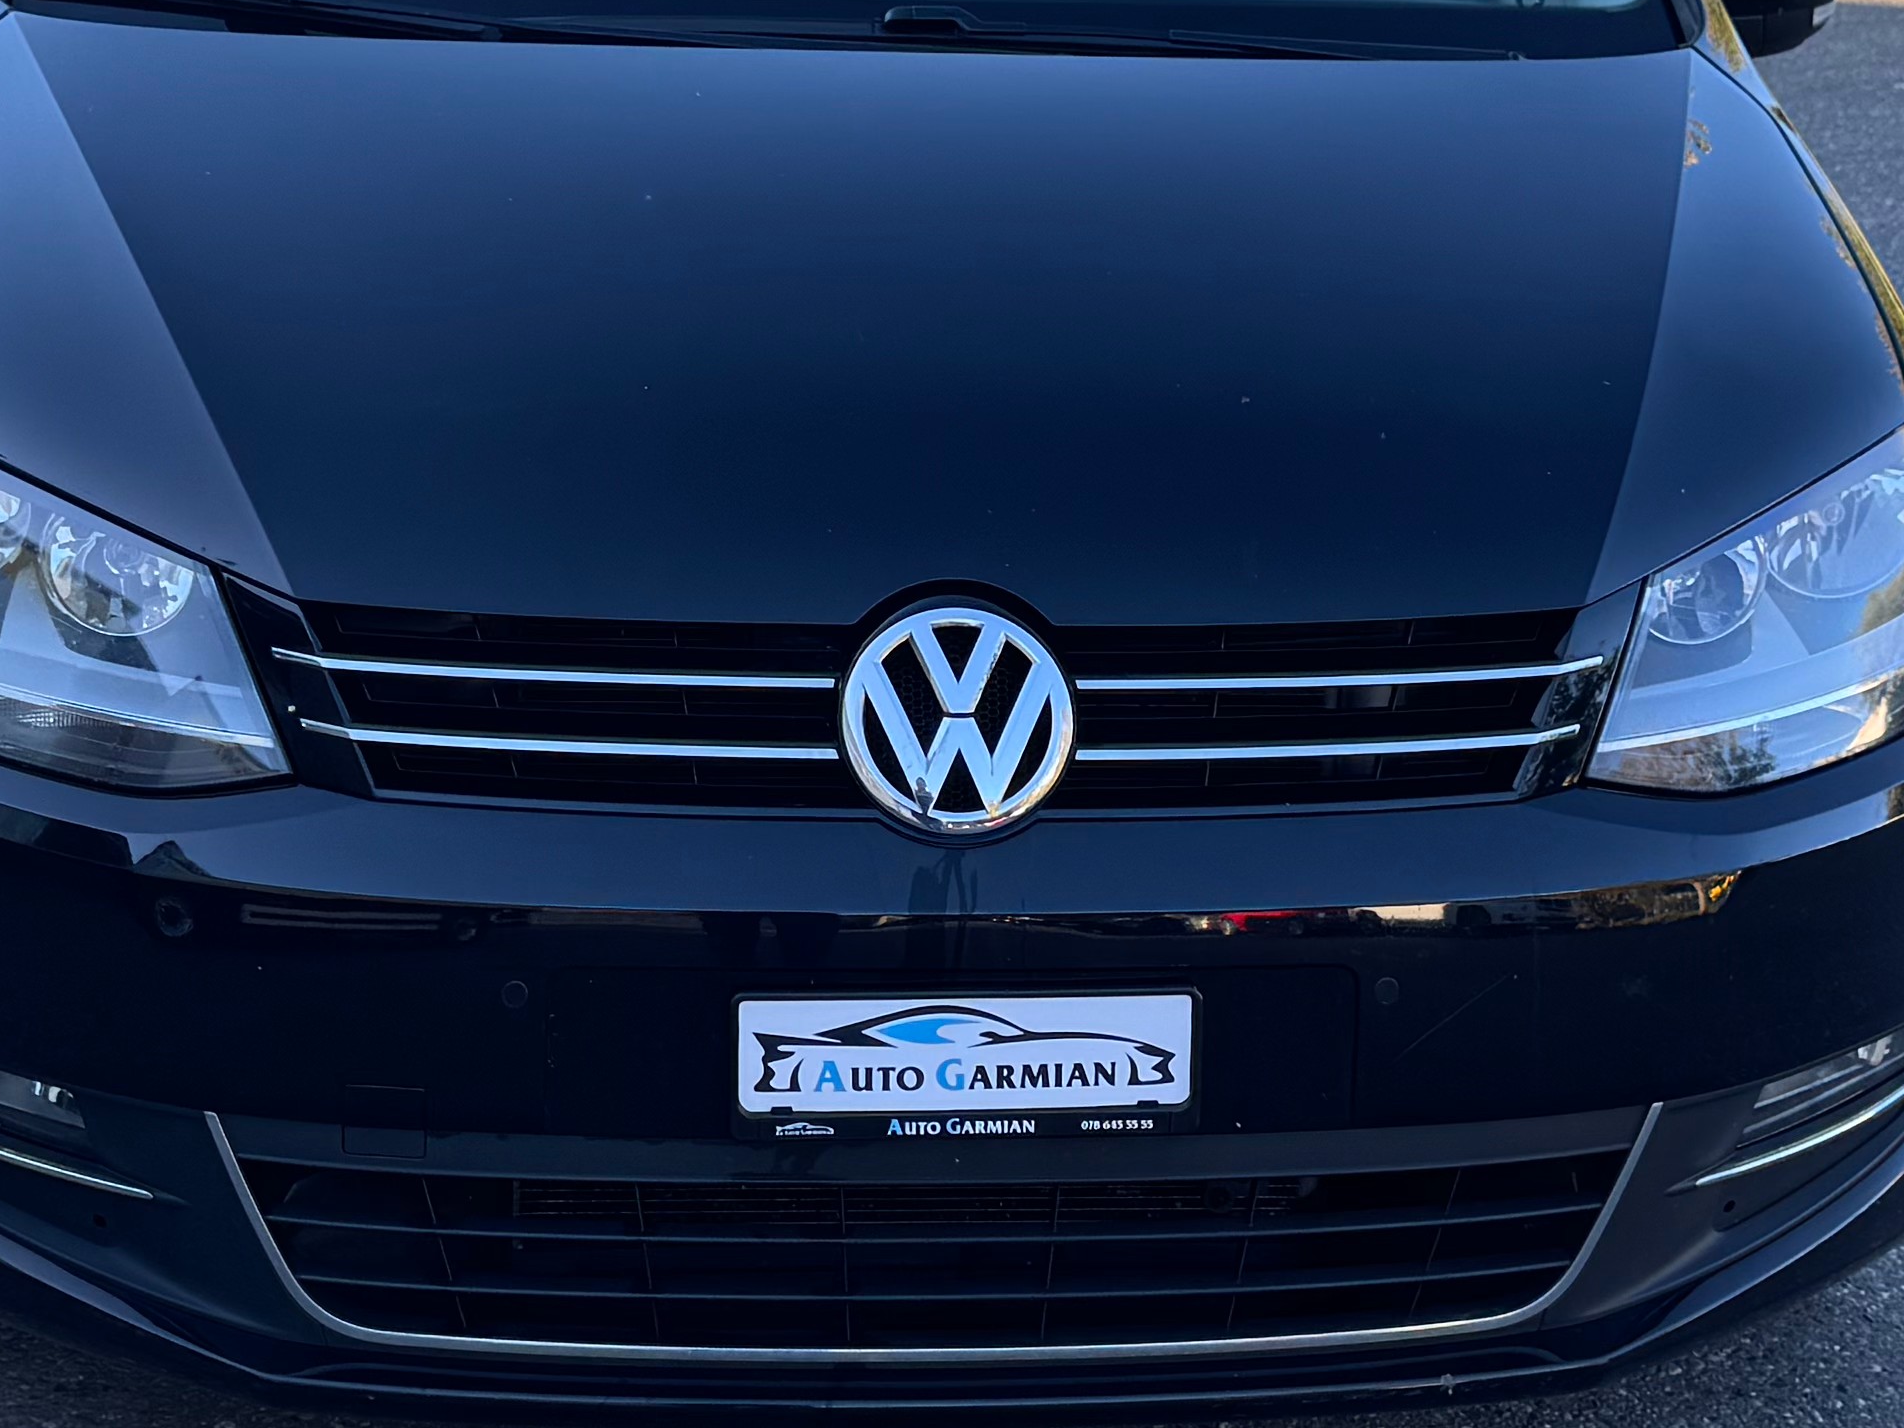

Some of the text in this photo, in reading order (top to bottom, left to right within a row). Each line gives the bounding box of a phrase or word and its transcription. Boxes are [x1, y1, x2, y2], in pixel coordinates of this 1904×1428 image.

[848, 610, 1069, 828] VW
[814, 1058, 1117, 1093] AUTO GARMIAN
[888, 1117, 1036, 1135] AUTO GARMIAN
